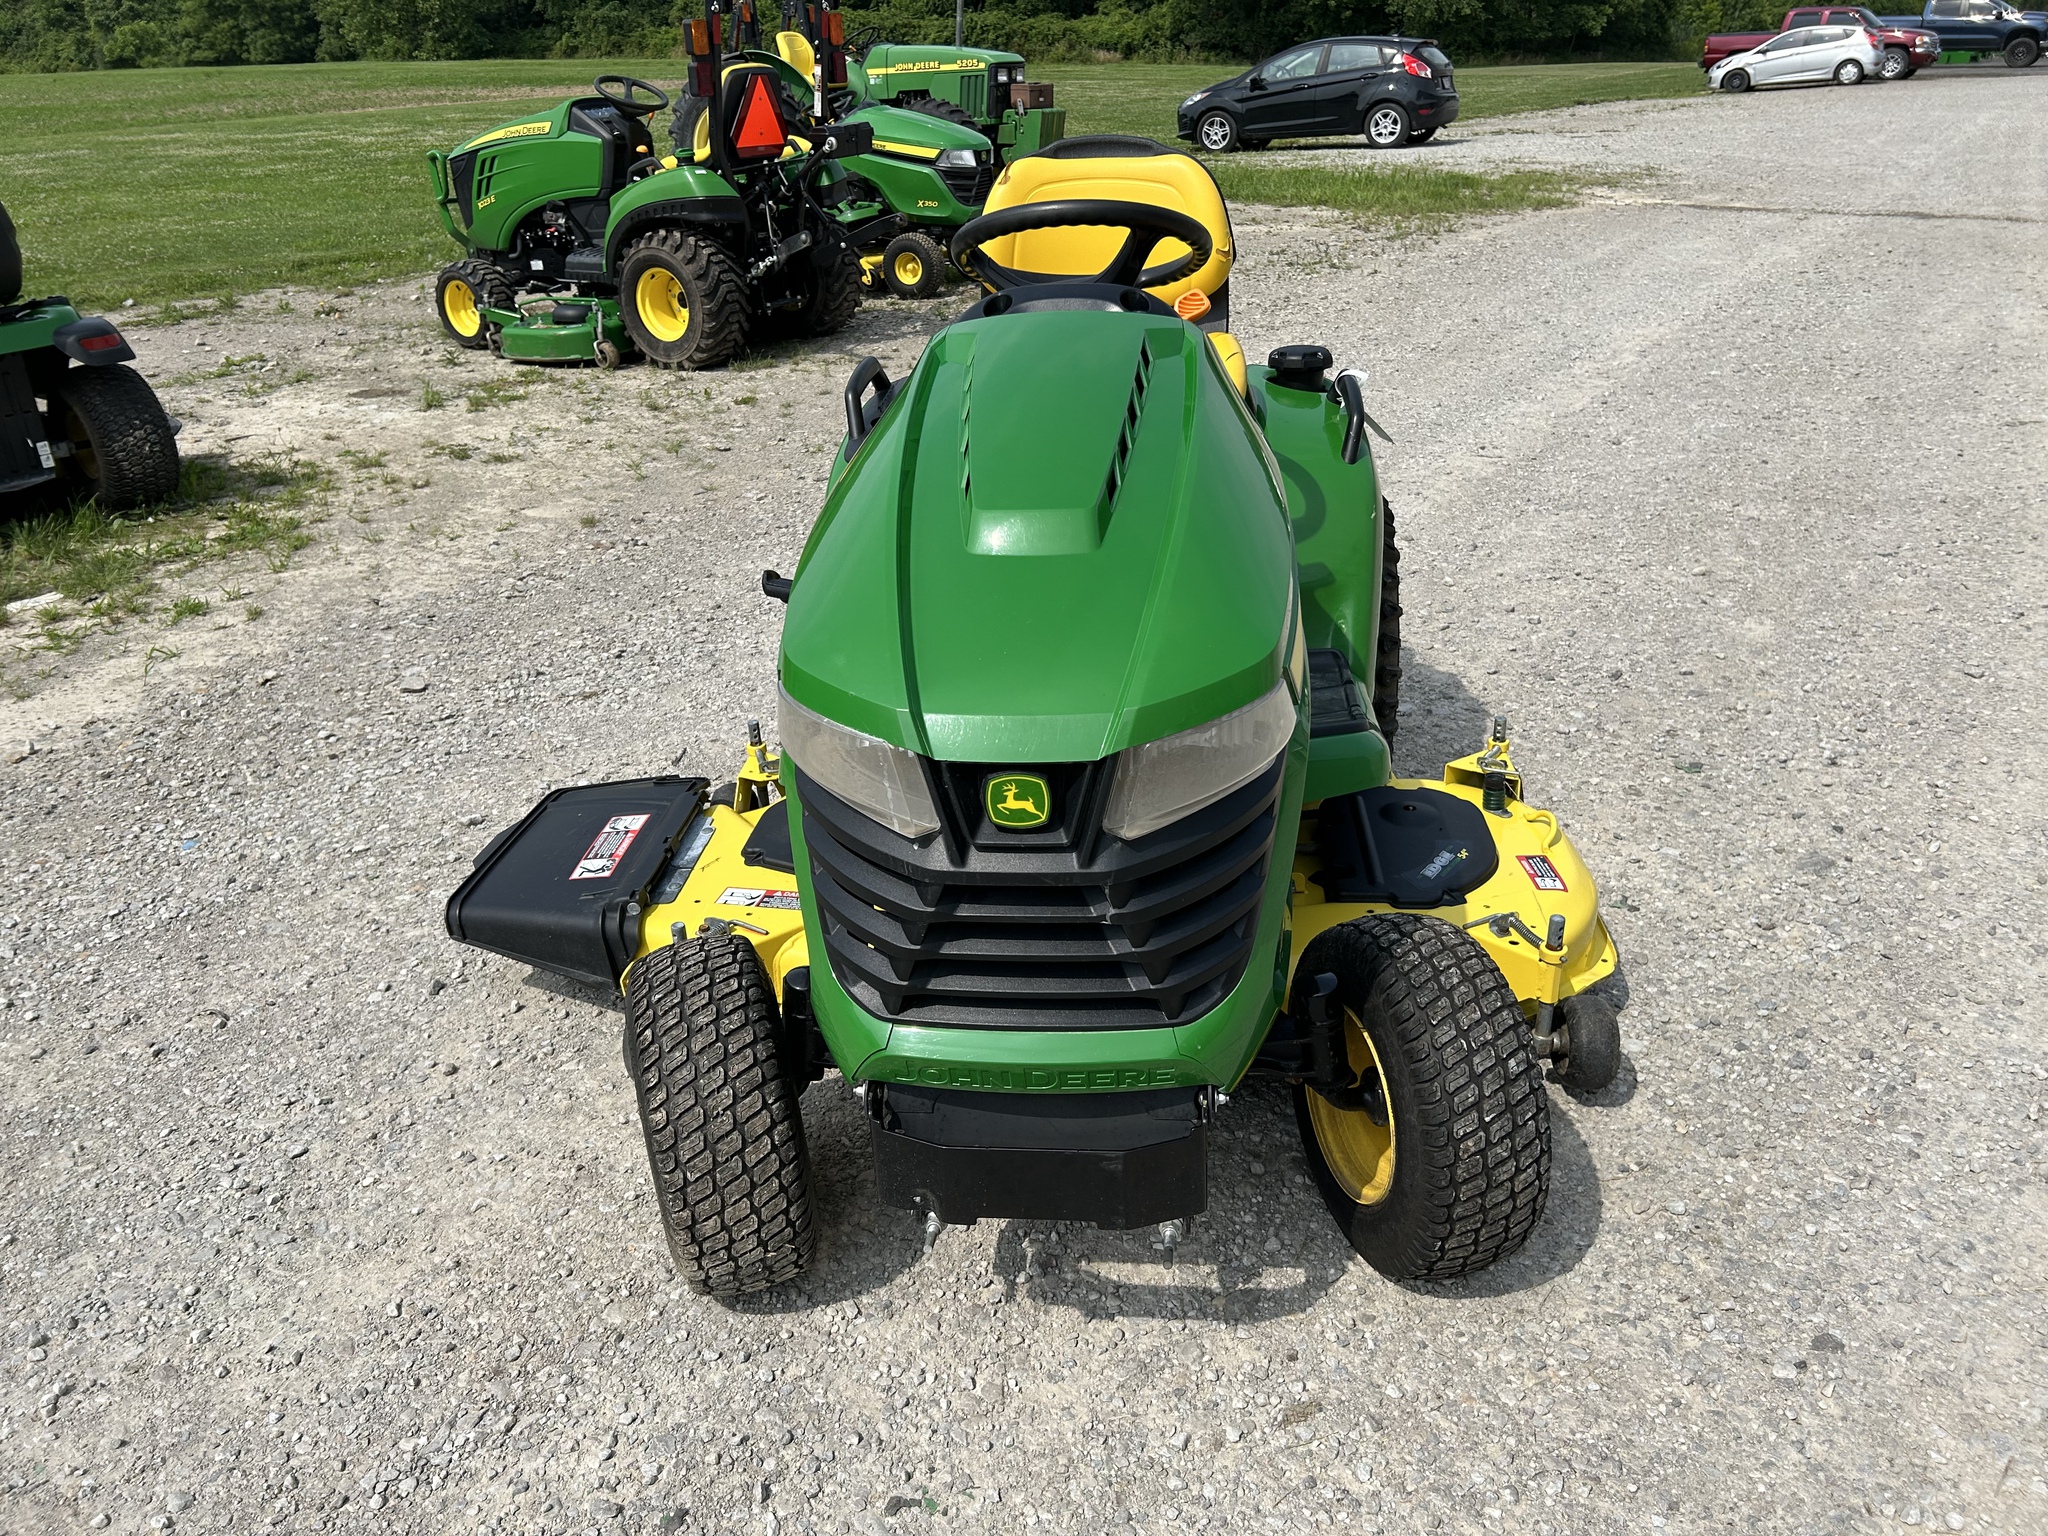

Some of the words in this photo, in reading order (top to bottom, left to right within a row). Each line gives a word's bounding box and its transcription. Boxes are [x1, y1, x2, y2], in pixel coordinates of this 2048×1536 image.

[894, 62, 914, 71] JOHN
[915, 61, 940, 70] DEERE
[956, 59, 979, 68] 5205
[502, 128, 521, 137] JOHN
[522, 126, 546, 134] DEERE
[1420, 850, 1455, 879] EDGE
[895, 1060, 1012, 1088] JOHN
[1023, 1067, 1175, 1090] DEERE
